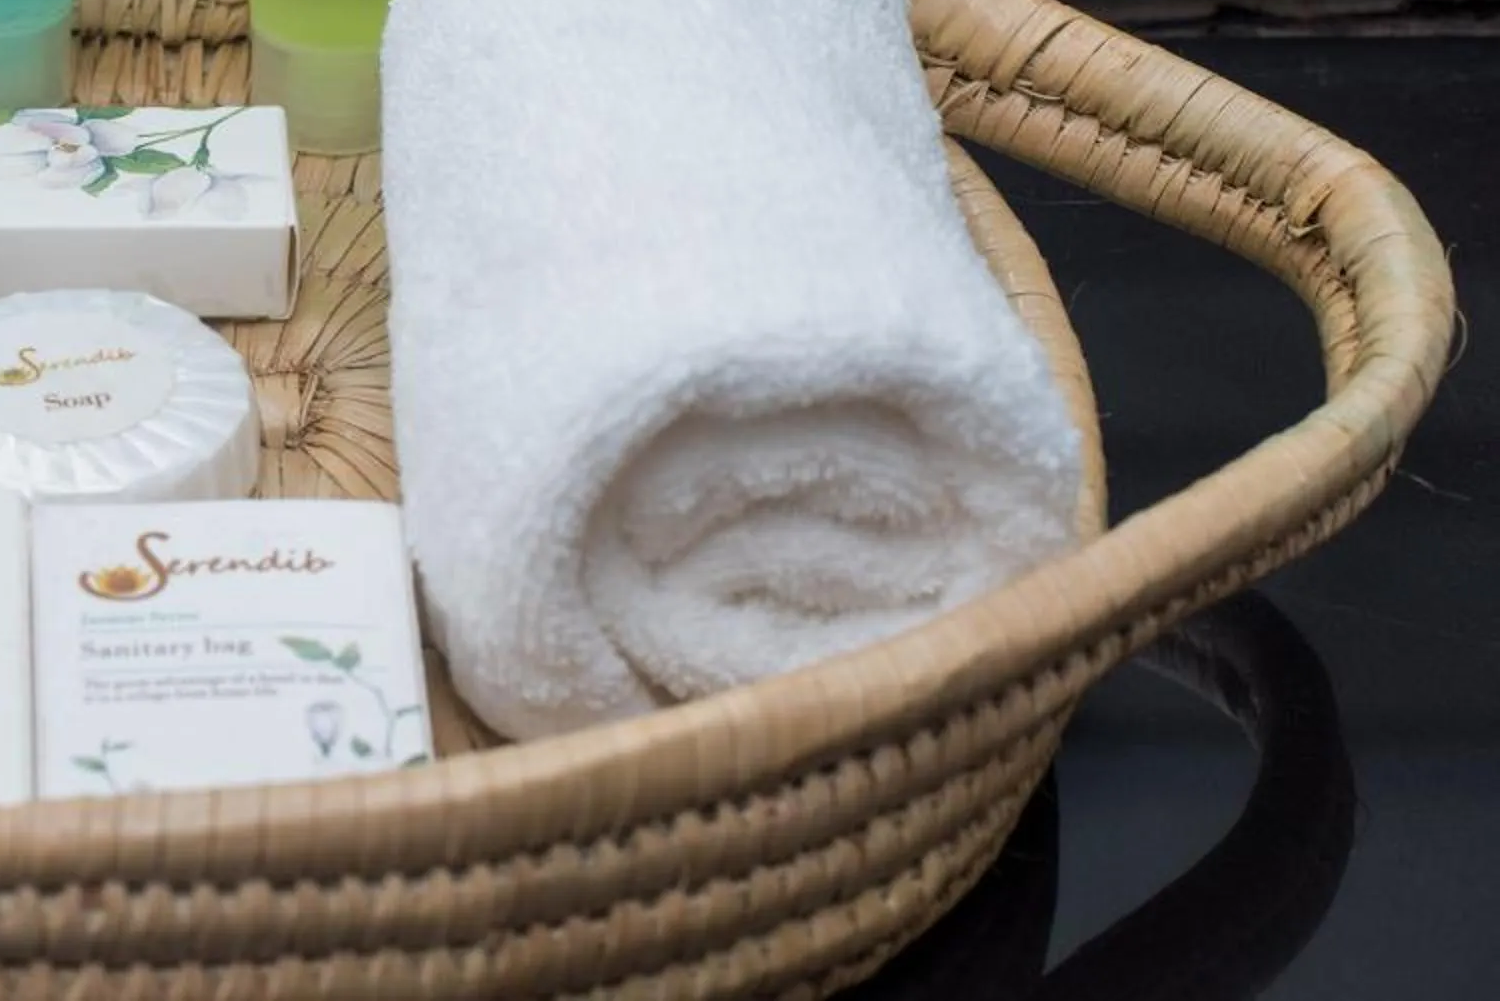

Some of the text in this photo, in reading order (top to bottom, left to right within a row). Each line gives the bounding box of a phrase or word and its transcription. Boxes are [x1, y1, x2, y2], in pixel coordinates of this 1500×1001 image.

[43, 391, 112, 412] Soap
[79, 531, 336, 601] Serendib
[80, 635, 254, 662] Sanitary bag
